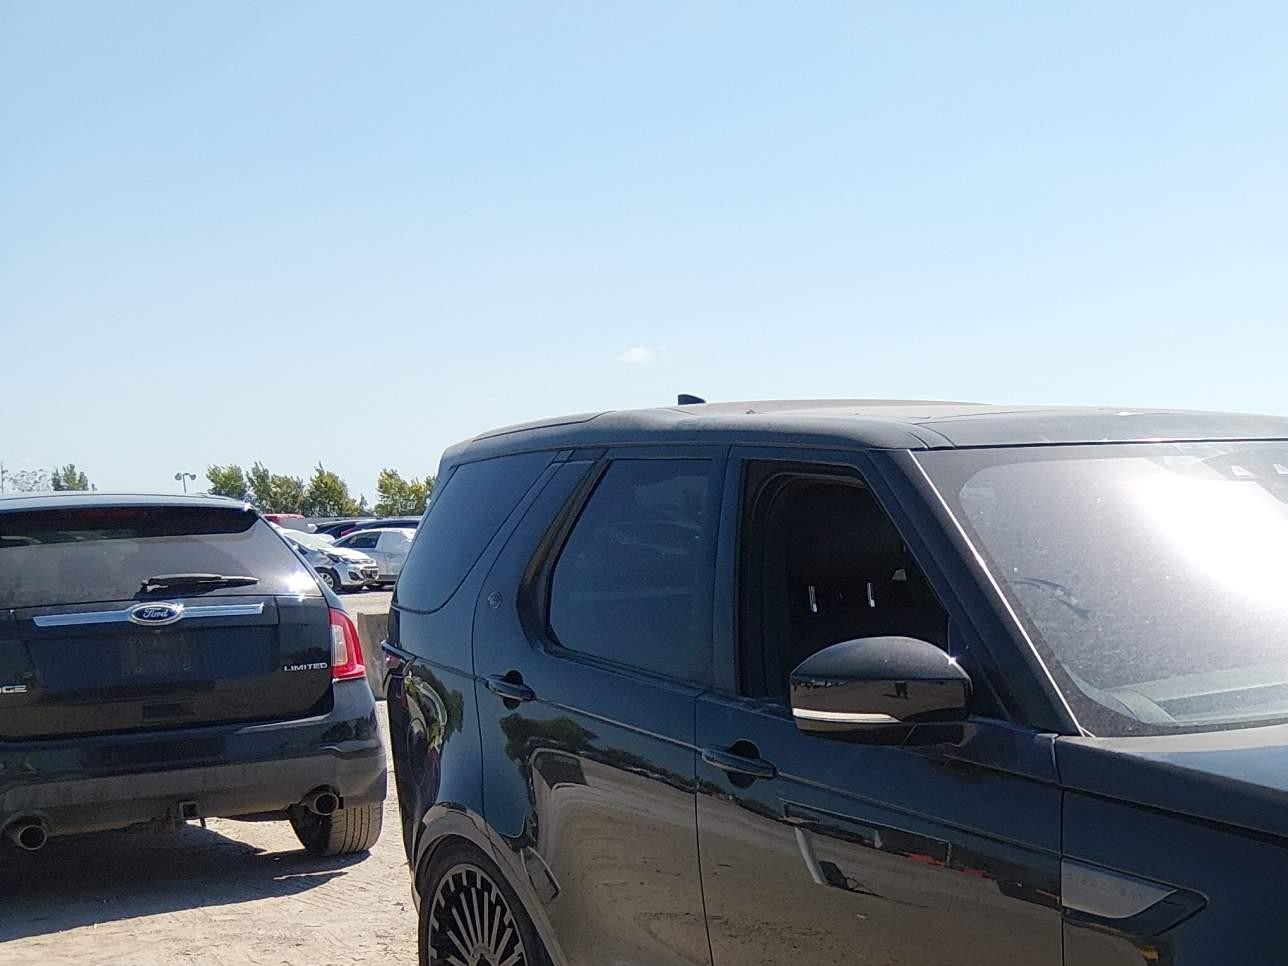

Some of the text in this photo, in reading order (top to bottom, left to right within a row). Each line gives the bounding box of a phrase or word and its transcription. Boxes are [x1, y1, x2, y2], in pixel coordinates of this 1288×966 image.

[142, 607, 169, 618] Ford
[283, 662, 328, 672] LIMITED
[0, 684, 28, 694] GE
